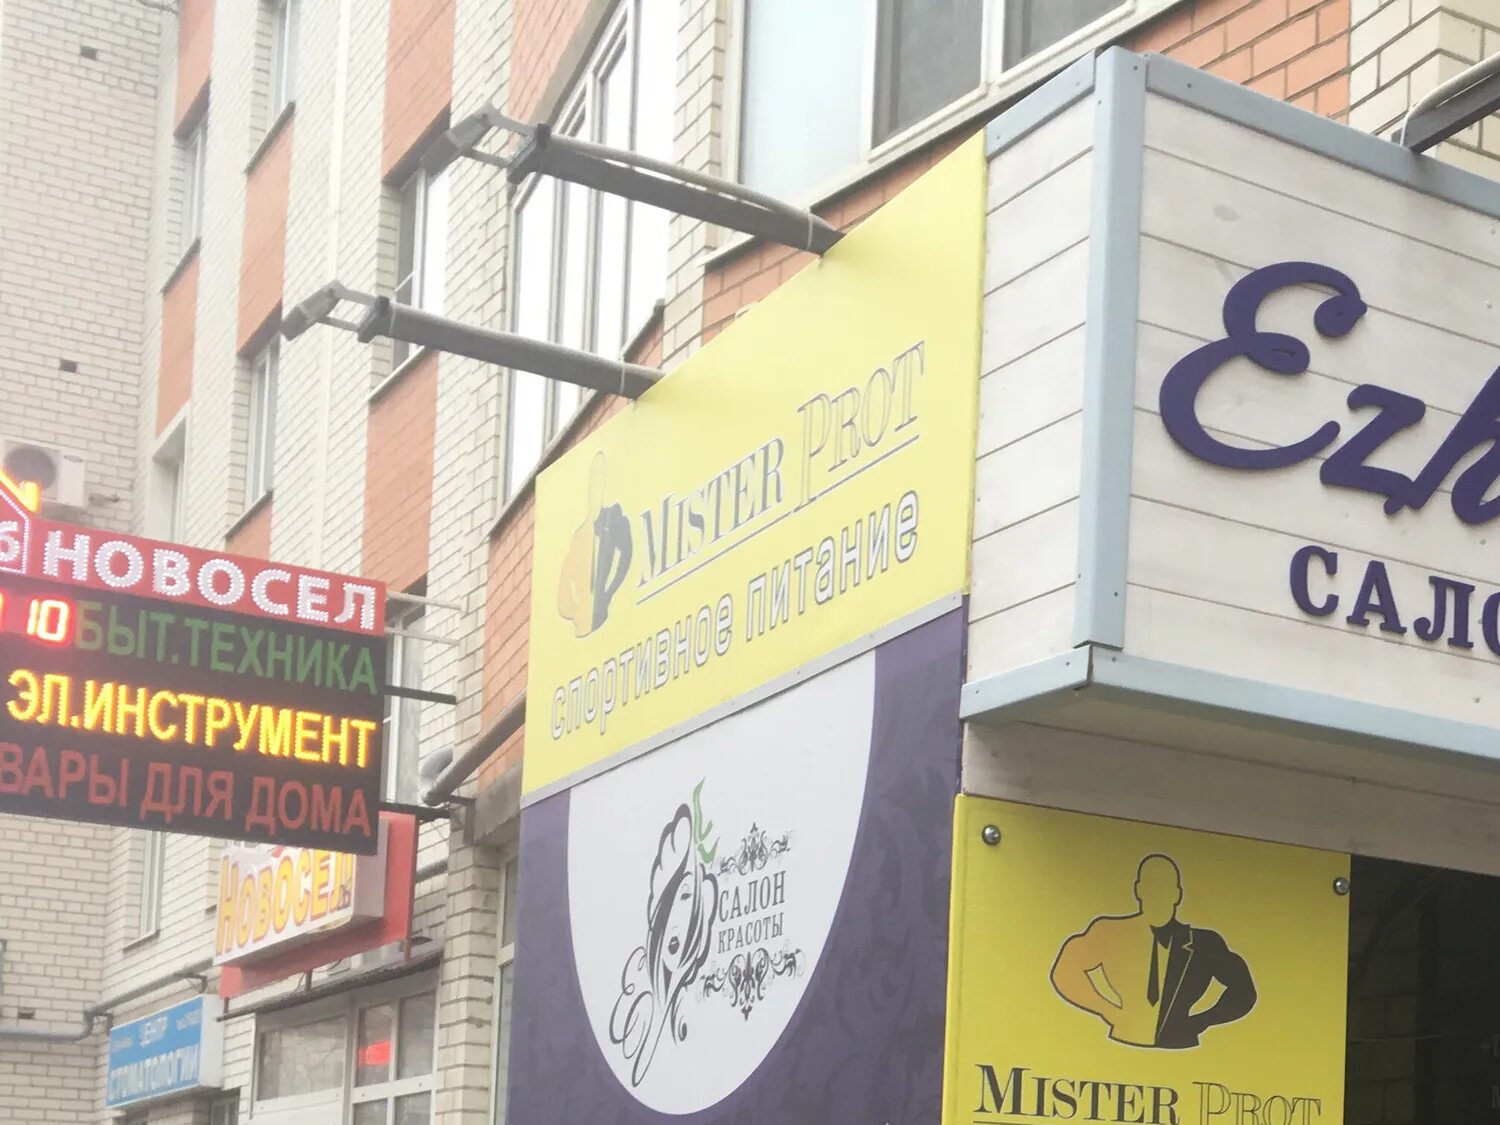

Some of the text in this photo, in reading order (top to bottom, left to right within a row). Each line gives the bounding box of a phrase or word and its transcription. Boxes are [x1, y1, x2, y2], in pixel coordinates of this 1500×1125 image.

[636, 438, 785, 588] MISTER
[42, 529, 376, 631] НОВОСЕЛ
[550, 489, 919, 740] спортивное питание
[75, 602, 378, 694] БЫТ.ТЕХНИКА
[8, 669, 377, 768] ЭЛ.ИНСТРУМЕНТ
[140, 762, 235, 823] ДЛЯ
[244, 777, 371, 836] ДОМА
[717, 913, 784, 954] КРАСОТЫ
[718, 871, 787, 923] САЛОН
